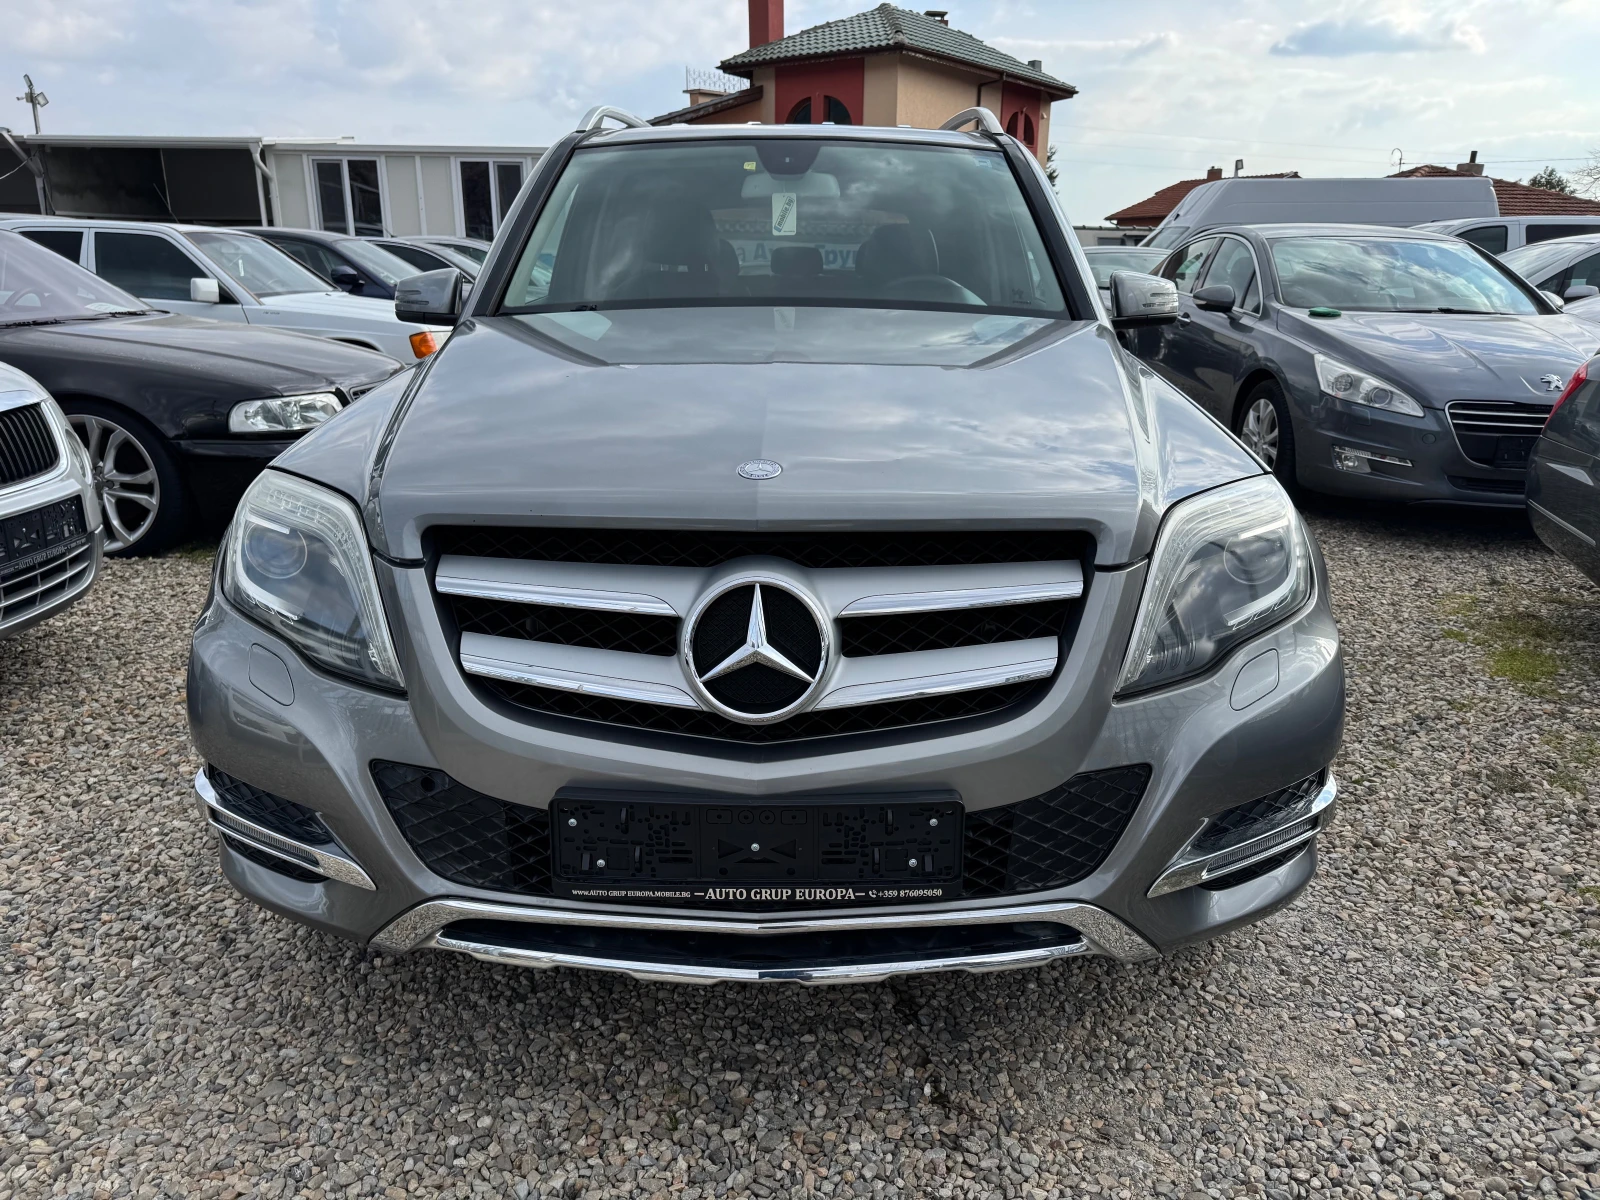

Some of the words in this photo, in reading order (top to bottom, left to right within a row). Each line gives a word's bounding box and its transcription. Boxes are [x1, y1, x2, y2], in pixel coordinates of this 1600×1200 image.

[776, 198, 794, 228] mobile.bg
[627, 890, 691, 898] EUROPA.MOBILE.BG
[750, 888, 792, 900] GRUP
[878, 889, 898, 898] +359
[899, 888, 943, 898] 876095050
